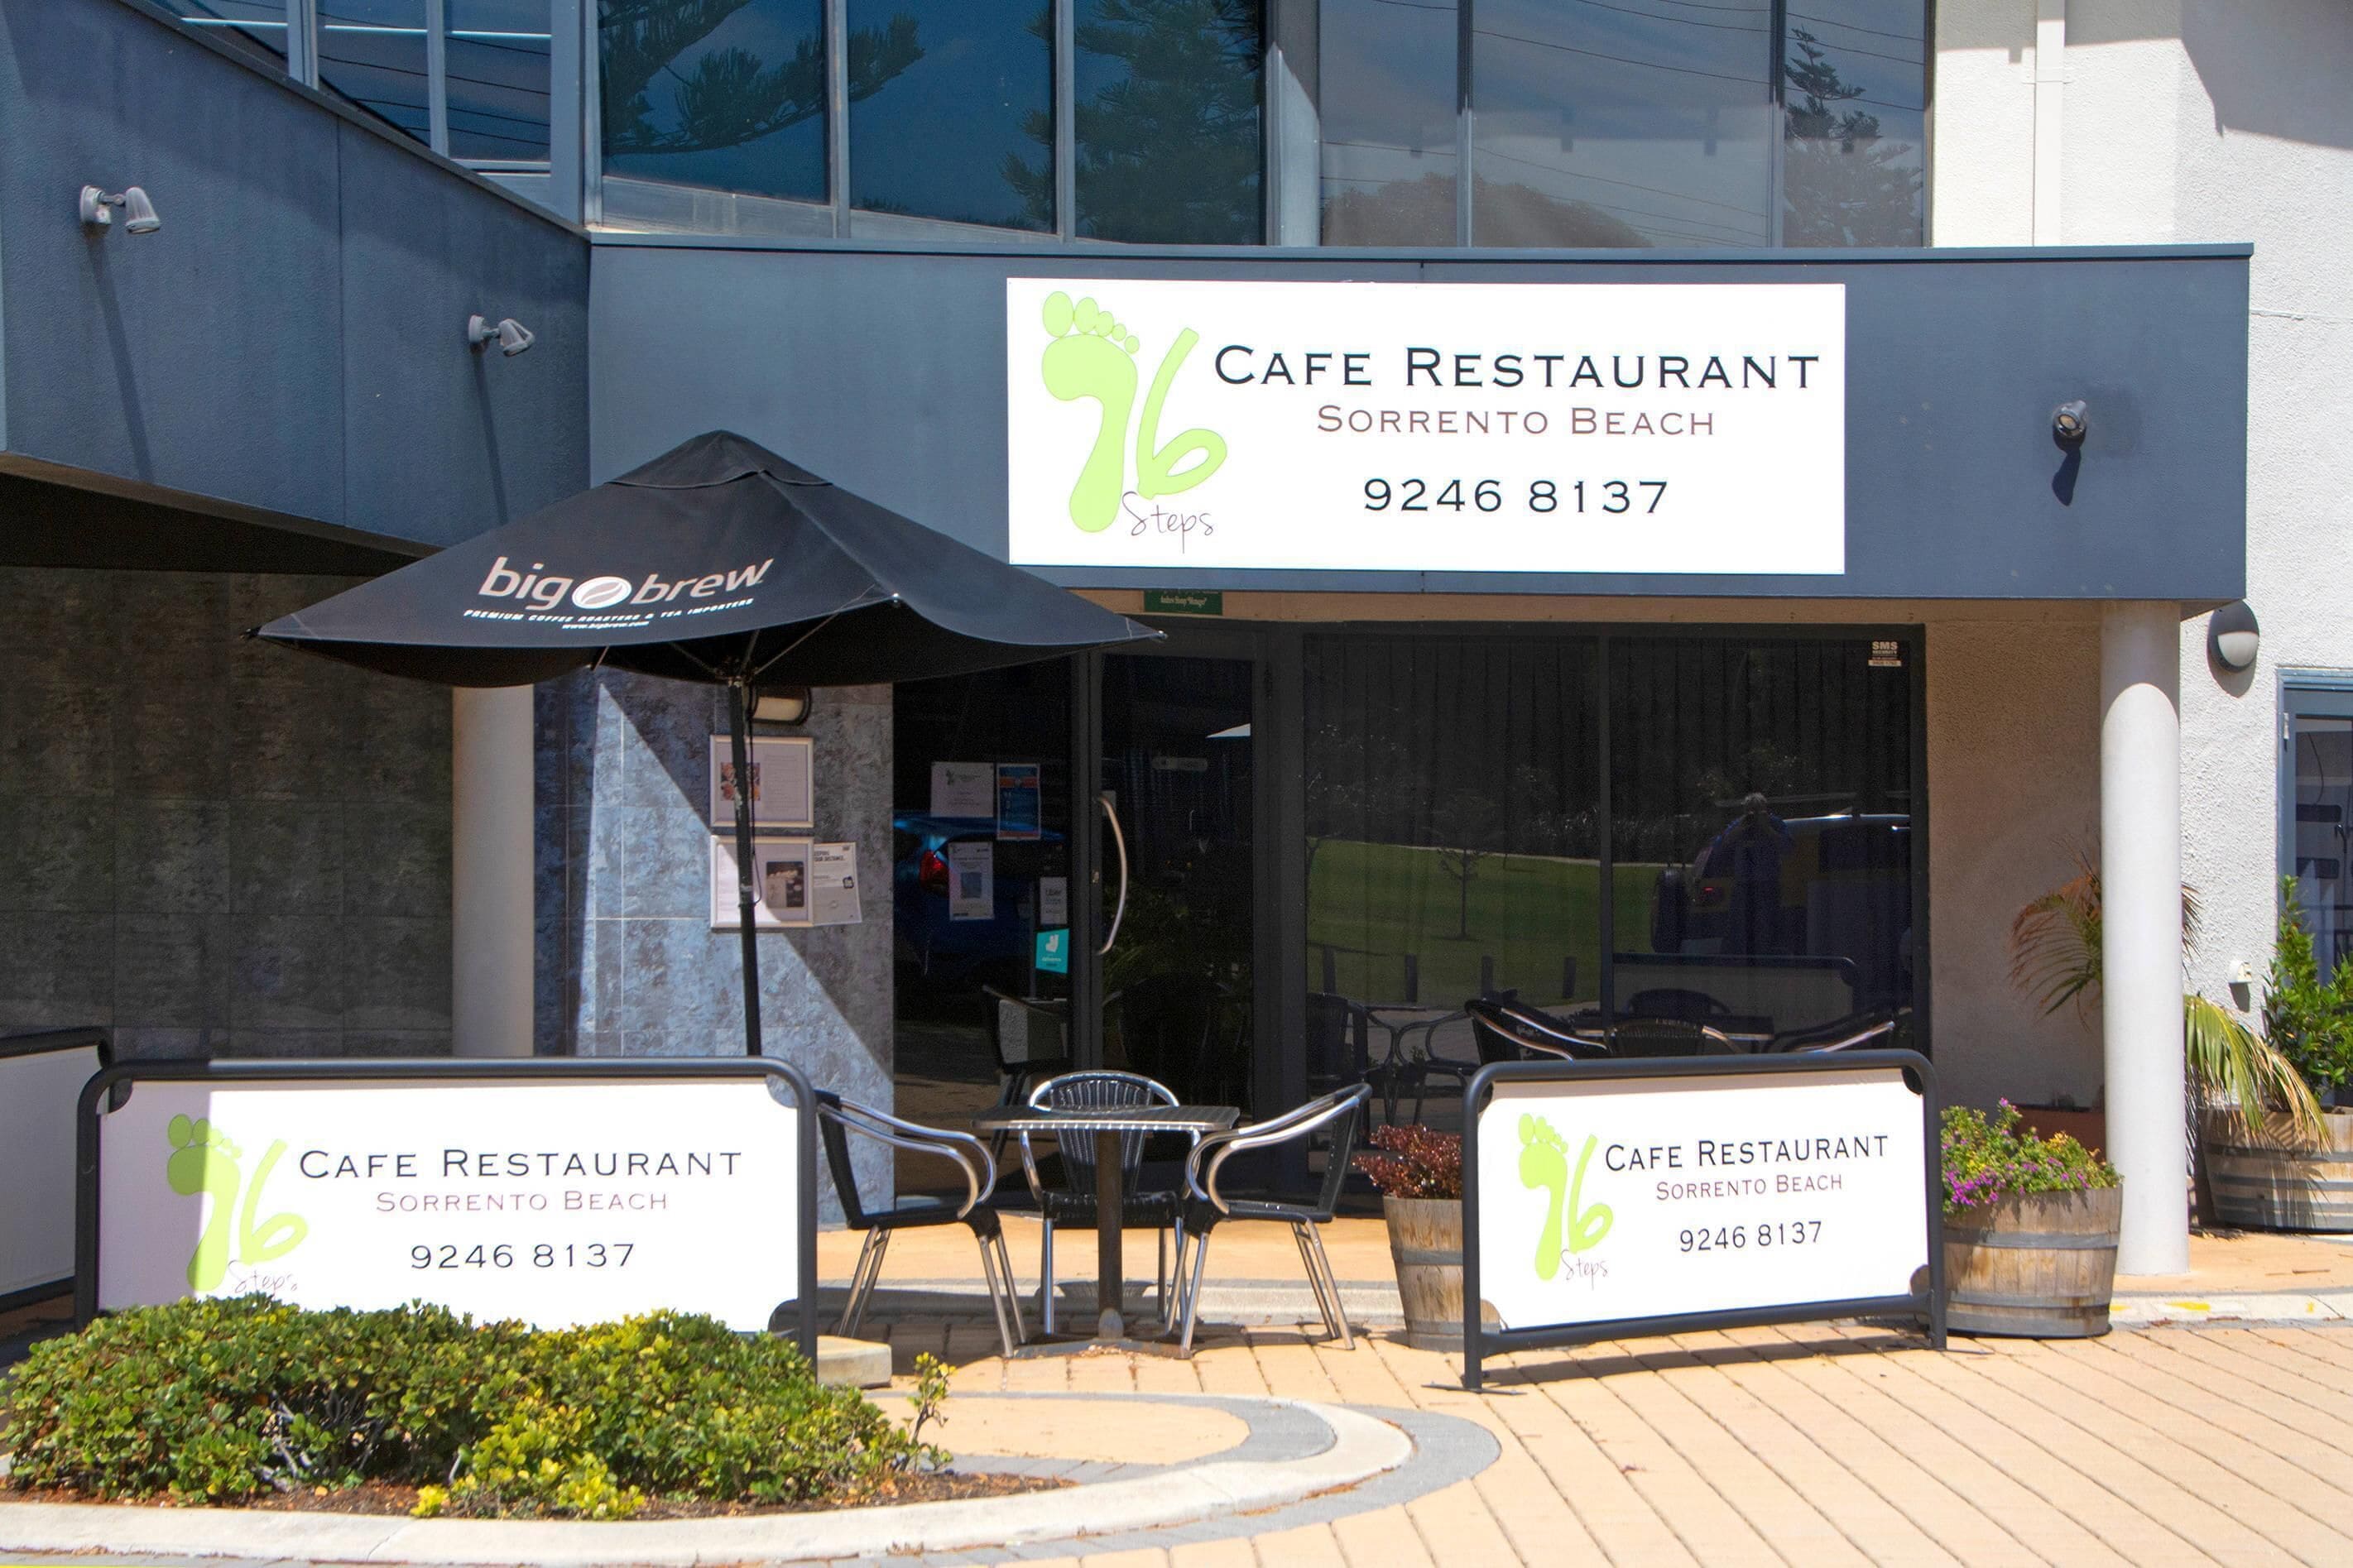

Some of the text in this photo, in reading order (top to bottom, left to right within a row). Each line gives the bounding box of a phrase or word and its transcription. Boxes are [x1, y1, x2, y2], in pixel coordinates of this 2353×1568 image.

[1364, 477, 1668, 514] 9246 8137
[1122, 491, 1214, 554] Steps
[478, 556, 775, 611] big brew
[463, 609, 524, 621] PREMIUM
[578, 614, 641, 623] ROASTERS
[660, 610, 683, 618] TEA
[687, 597, 755, 616] IMPORTERS
[1872, 641, 1898, 650] SMS
[1678, 1220, 1823, 1253] 9246 8137
[411, 1243, 634, 1269] 9246 8137
[1560, 1248, 1609, 1291] Steps
